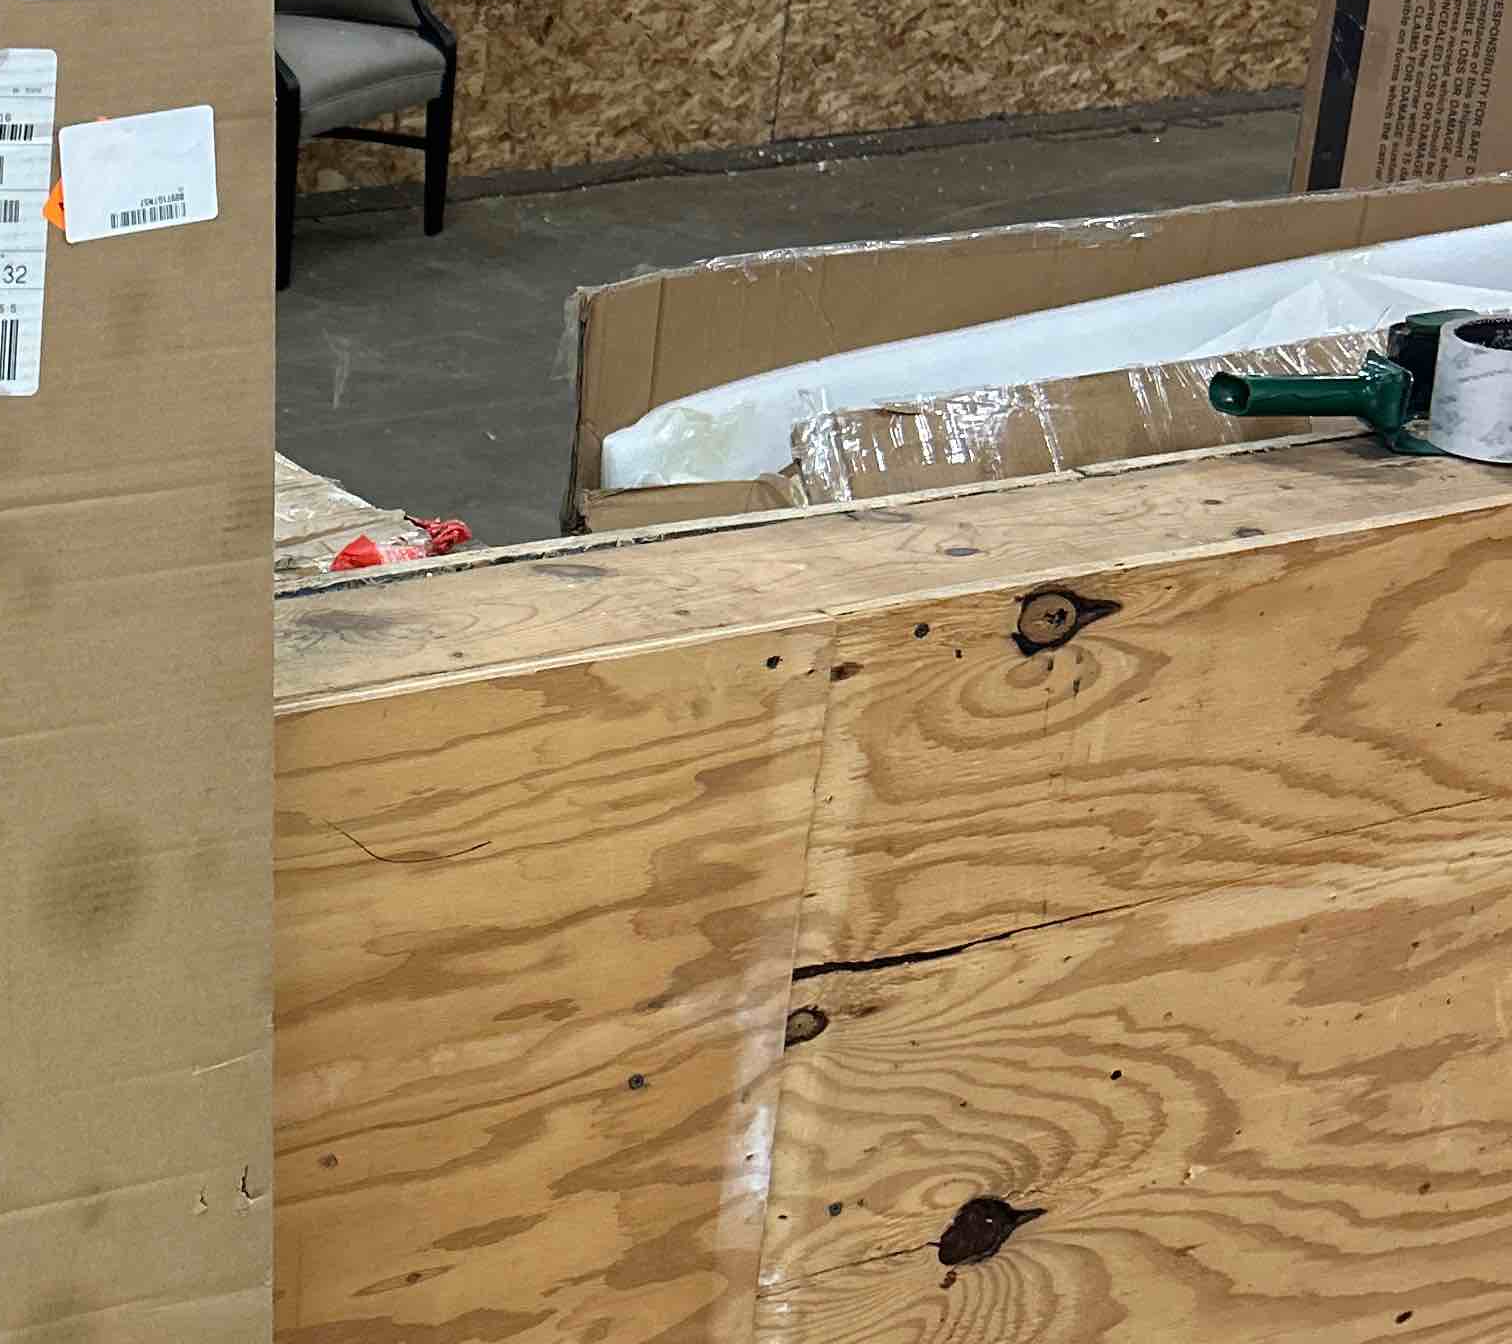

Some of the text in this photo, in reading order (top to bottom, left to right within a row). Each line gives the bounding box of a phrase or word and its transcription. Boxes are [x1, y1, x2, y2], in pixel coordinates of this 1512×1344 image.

[1397, 30, 1406, 45] on
[1409, 5, 1425, 53] CLAIMS
[1422, 34, 1432, 46] to
[1391, 47, 1405, 82] forms
[1403, 56, 1416, 83] FOR
[1418, 48, 1428, 68] the
[1455, 39, 1470, 75] LOSS
[1468, 62, 1479, 75] of
[1428, 65, 1440, 98] LOSS
[1453, 77, 1465, 97] OR
[1464, 76, 1478, 99] this
[1384, 85, 1397, 120] which
[1436, 79, 1448, 115] which
[1393, 85, 1411, 139] DAMAGE
[1422, 102, 1433, 121] OR
[1472, 100, 1488, 127] FOR
[1381, 122, 1392, 140] the
[1429, 118, 1442, 159] should
[1441, 99, 1460, 154] DAMAGE
[1412, 123, 1430, 177] DAMAGE
[1467, 130, 1482, 163] SAFE
[1425, 161, 1436, 176] be
[9, 303, 17, 314] 5
